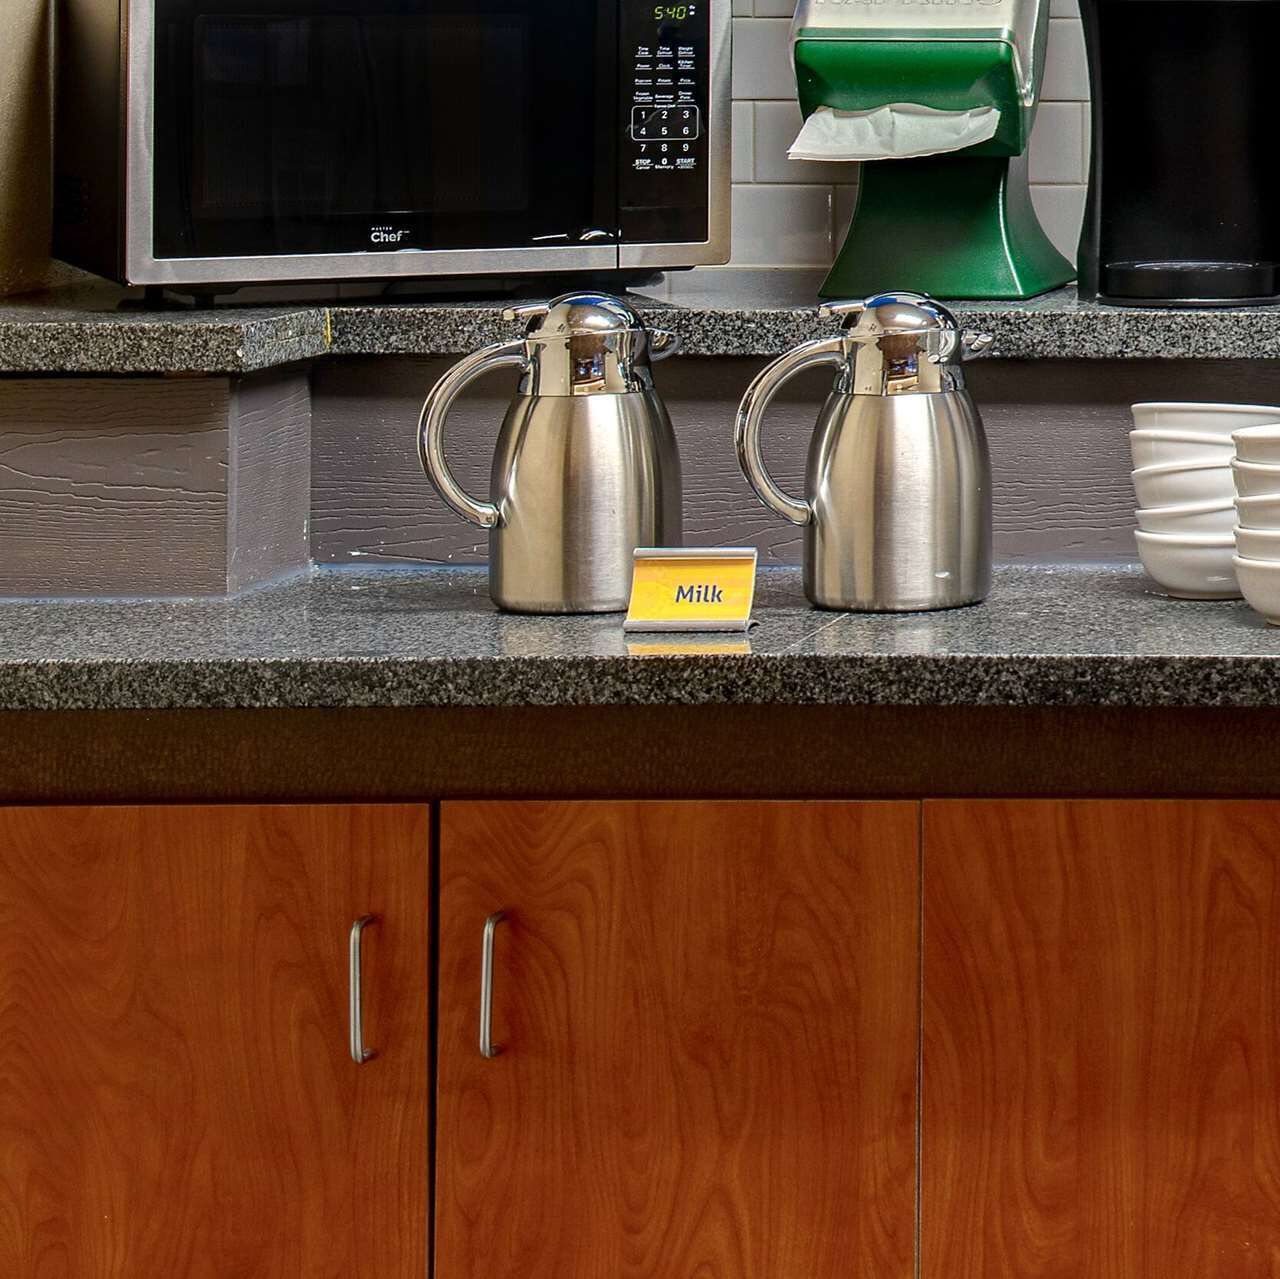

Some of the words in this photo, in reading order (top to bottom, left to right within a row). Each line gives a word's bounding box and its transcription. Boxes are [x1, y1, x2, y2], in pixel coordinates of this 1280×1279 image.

[641, 111, 646, 119] 1
[661, 110, 668, 119] 2
[682, 110, 690, 119] 3
[639, 127, 646, 135] 4
[661, 127, 668, 135] 5
[682, 126, 689, 135] 6
[640, 144, 646, 152] 7
[661, 143, 668, 152] 8
[682, 143, 689, 152] 9
[370, 230, 403, 242] Chef
[675, 584, 723, 603] Milk
